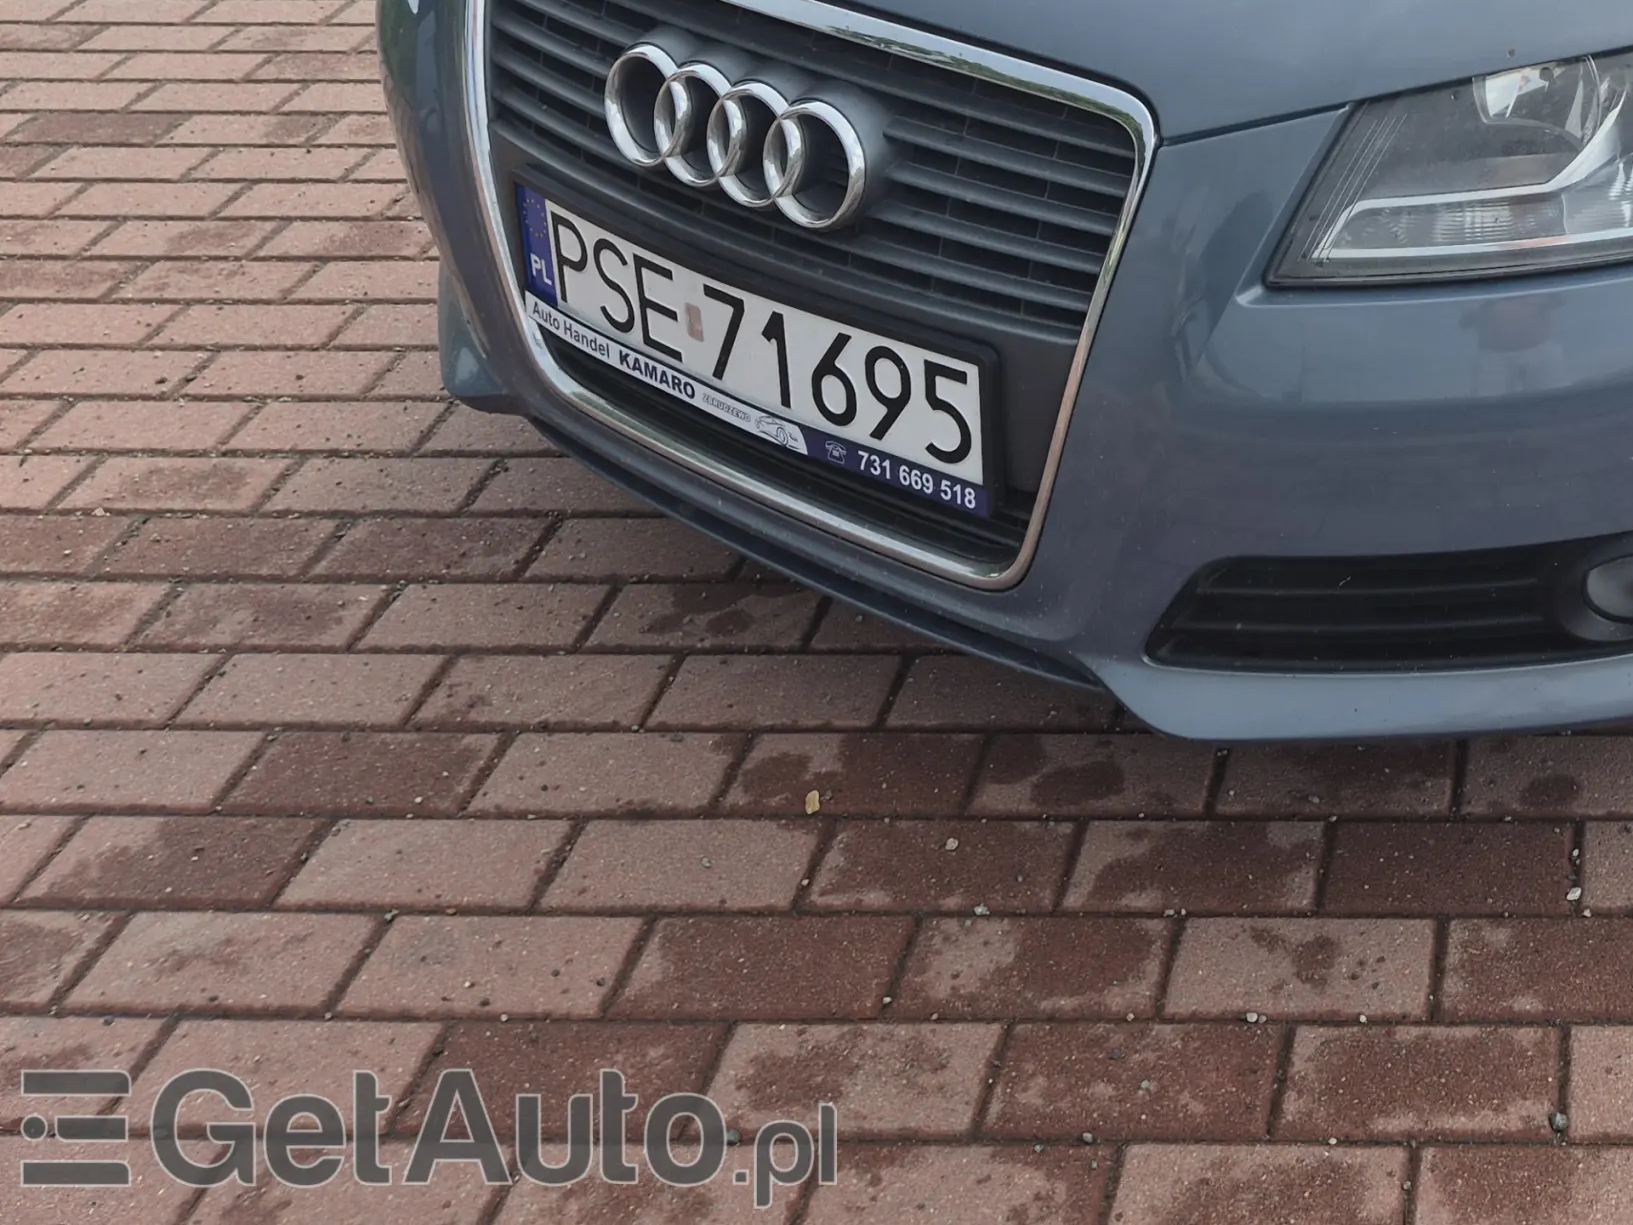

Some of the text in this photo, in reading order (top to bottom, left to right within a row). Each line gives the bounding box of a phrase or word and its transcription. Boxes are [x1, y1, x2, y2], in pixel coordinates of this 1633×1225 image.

[530, 252, 552, 286] PL
[533, 301, 752, 423] Auto Handel KAMARO ZBRUDZEWO
[857, 450, 977, 509] 731 669 518
